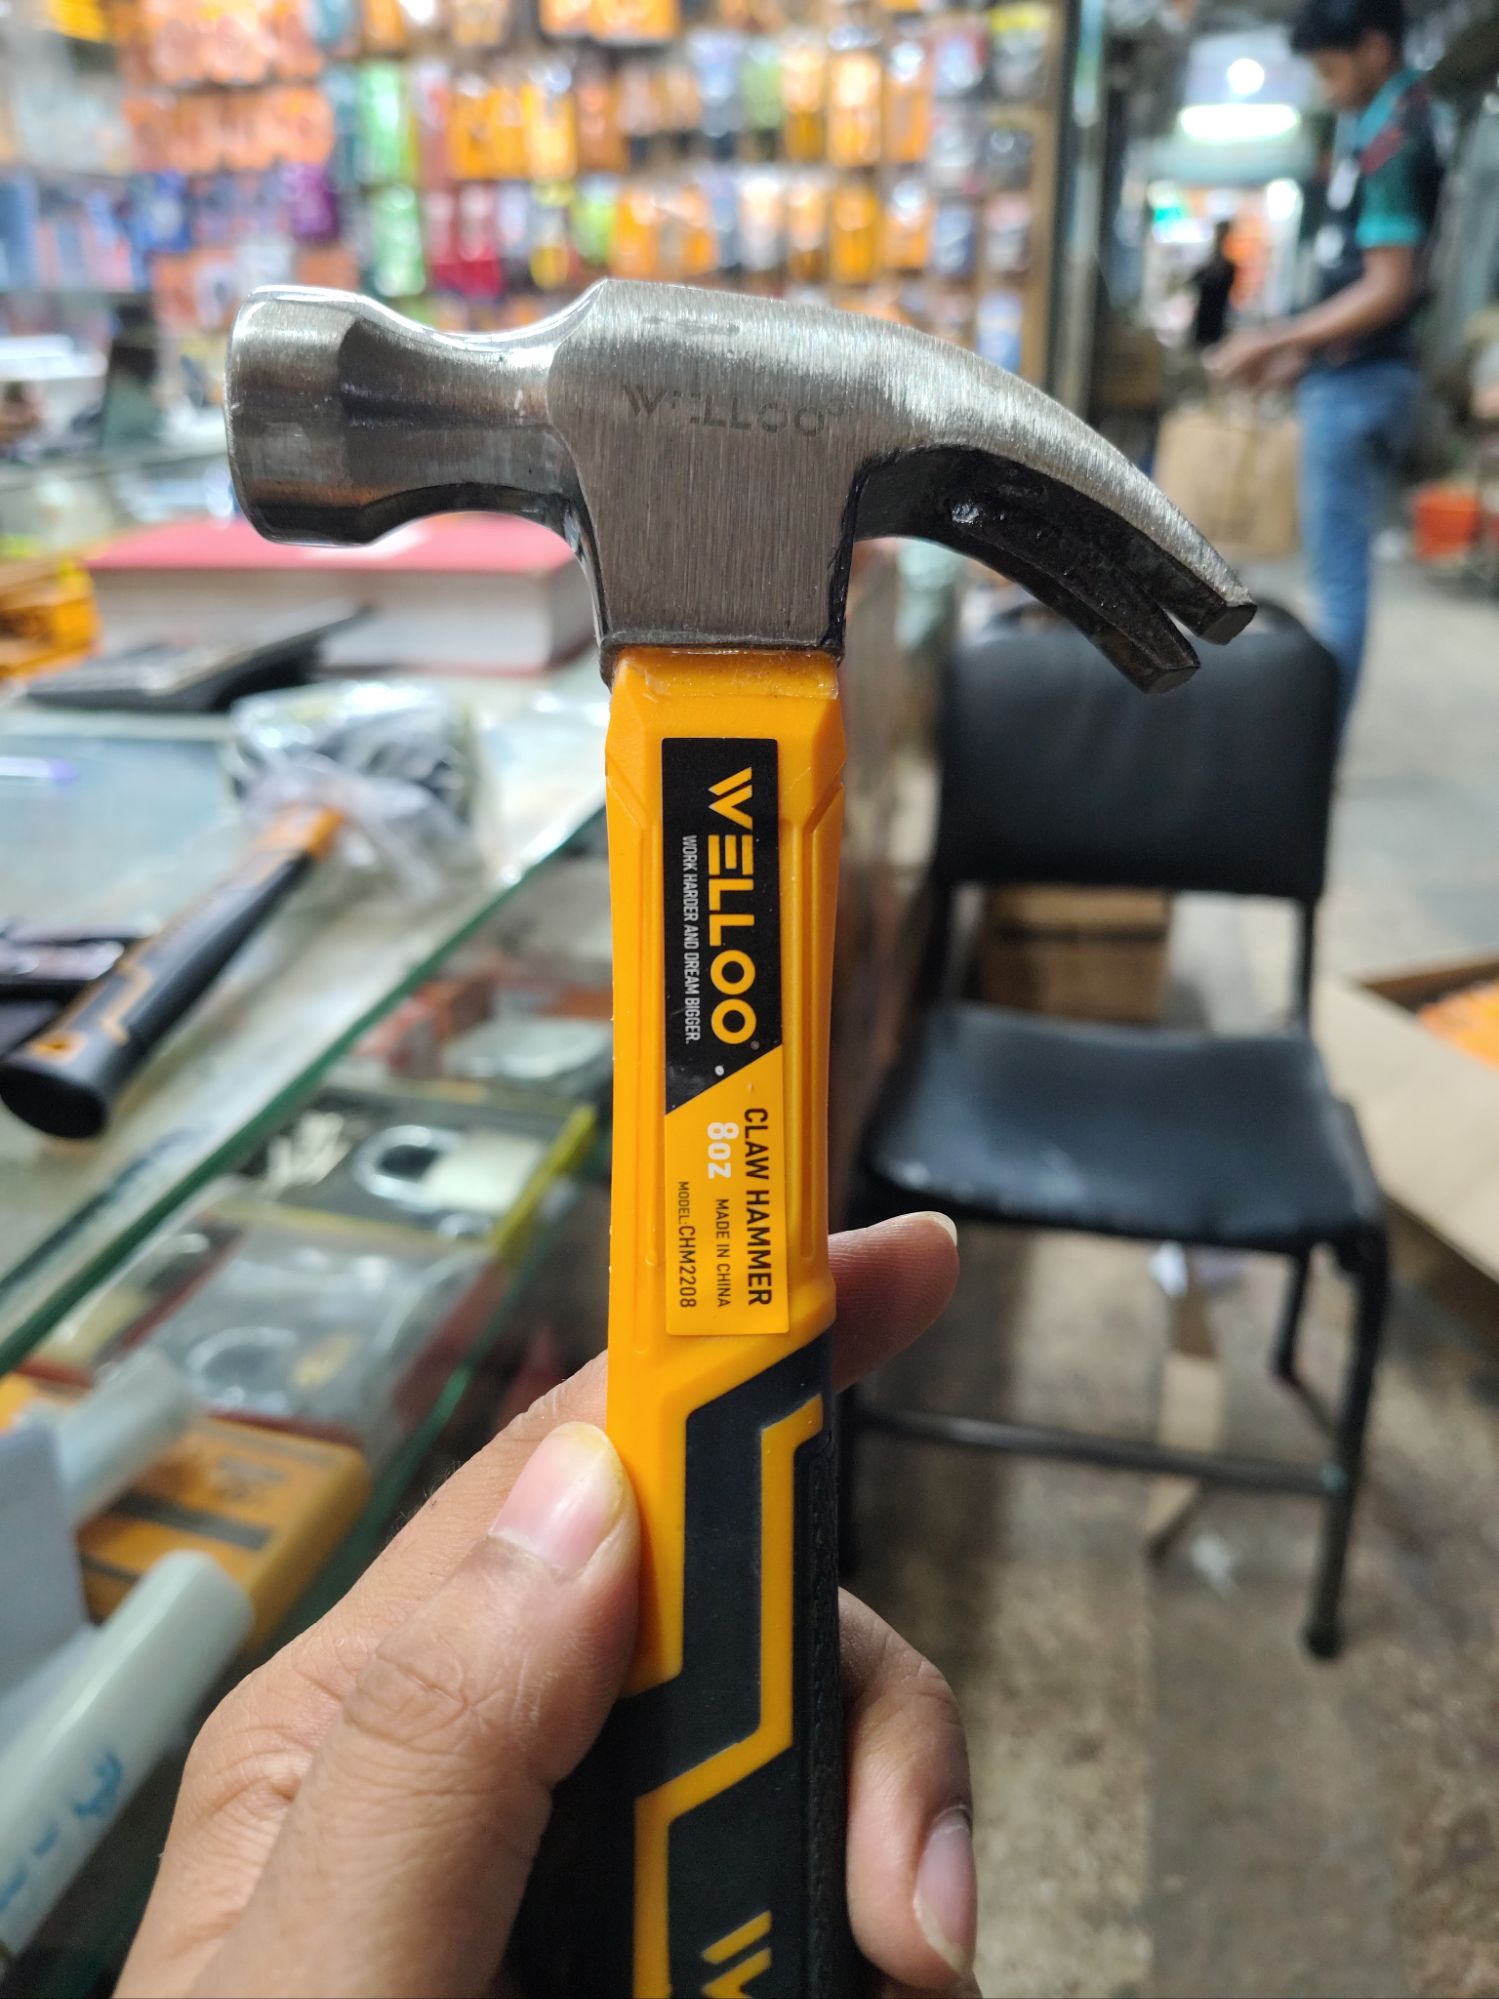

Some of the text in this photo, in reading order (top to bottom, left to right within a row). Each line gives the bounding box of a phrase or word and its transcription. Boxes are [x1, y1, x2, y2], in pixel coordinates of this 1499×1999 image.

[682, 835, 701, 1044] WORK HARDER AND DREAM BIGGER.
[708, 767, 757, 1045] WELLOO
[715, 1199, 731, 1307] MADE IN CHINA
[744, 1108, 772, 1306] CLAW HAMMER
